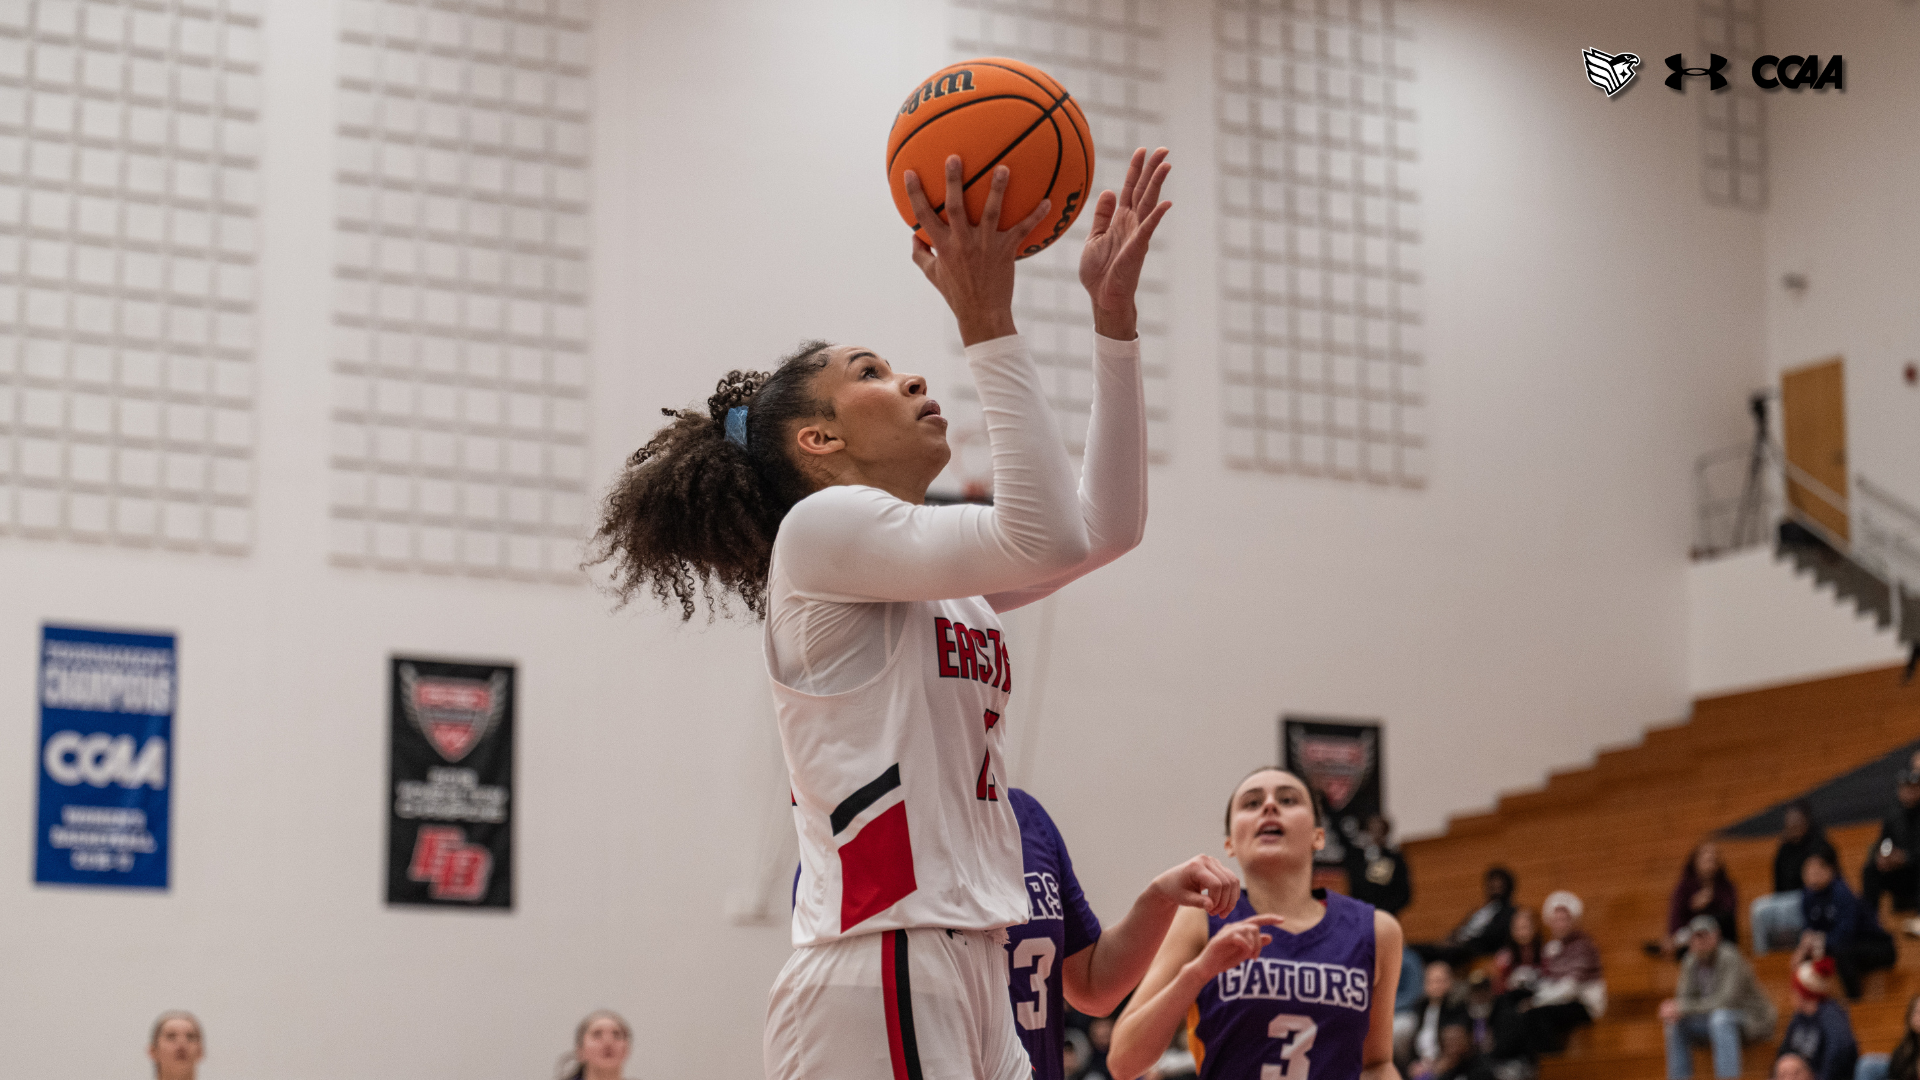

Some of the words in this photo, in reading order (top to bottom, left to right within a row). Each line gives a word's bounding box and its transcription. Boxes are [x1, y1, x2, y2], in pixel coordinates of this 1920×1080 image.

[1015, 188, 1082, 261] lson
[1219, 957, 1369, 1012] GATORS
[1260, 1013, 1318, 1080] 3
